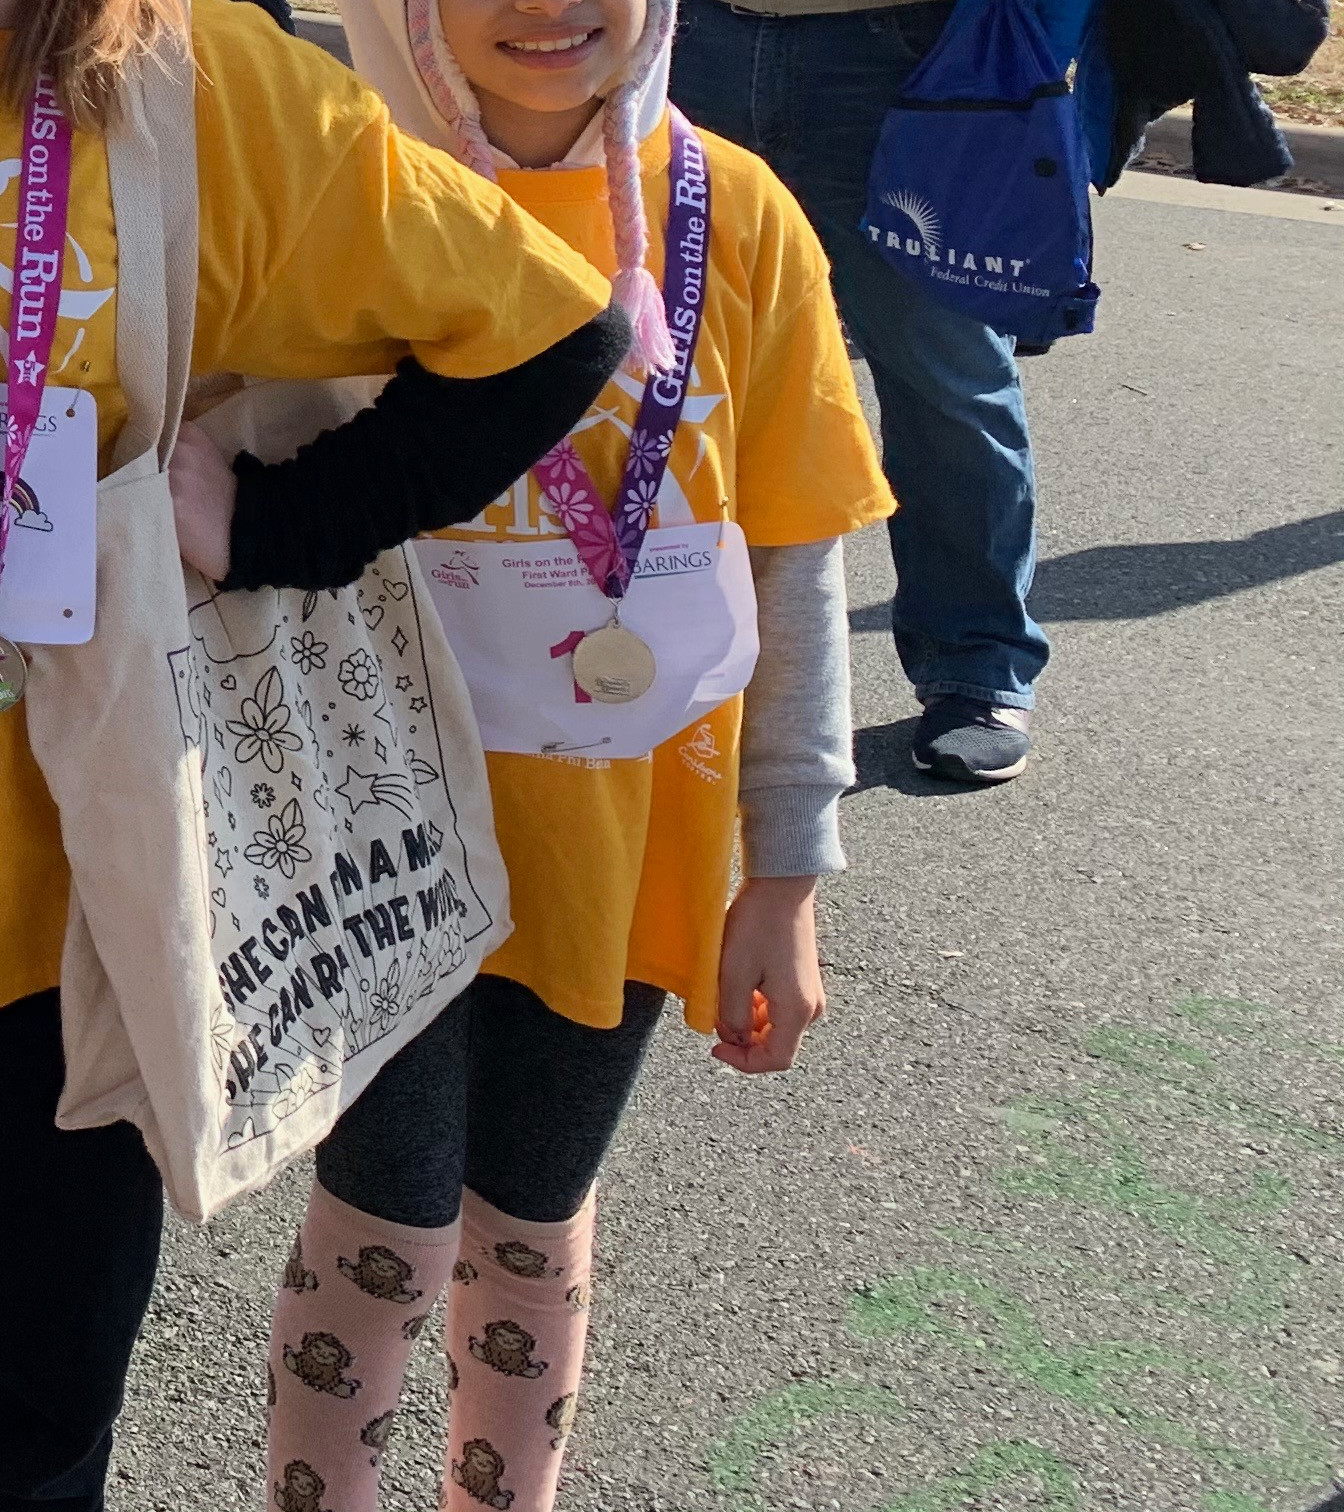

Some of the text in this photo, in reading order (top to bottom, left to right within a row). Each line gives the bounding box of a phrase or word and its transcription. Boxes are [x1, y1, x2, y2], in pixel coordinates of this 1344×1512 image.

[28, 145, 49, 186] on
[675, 138, 708, 214] Run
[23, 185, 54, 242] the
[684, 216, 706, 266] the
[868, 225, 1026, 277] TRULIANT
[16, 247, 59, 342] Run
[680, 266, 702, 306] on
[930, 265, 1050, 298] Federal Credit Union
[501, 557, 532, 569] Girls
[535, 559, 551, 568] on
[554, 556, 574, 567] the
[521, 569, 548, 580] First
[548, 568, 578, 580] Ward
[633, 551, 712, 575] BARINGS
[220, 934, 274, 1013] HE
[261, 882, 333, 962] CAN
[225, 1022, 269, 1100] HE
[268, 968, 315, 1047] CAN
[342, 894, 416, 959] THE
